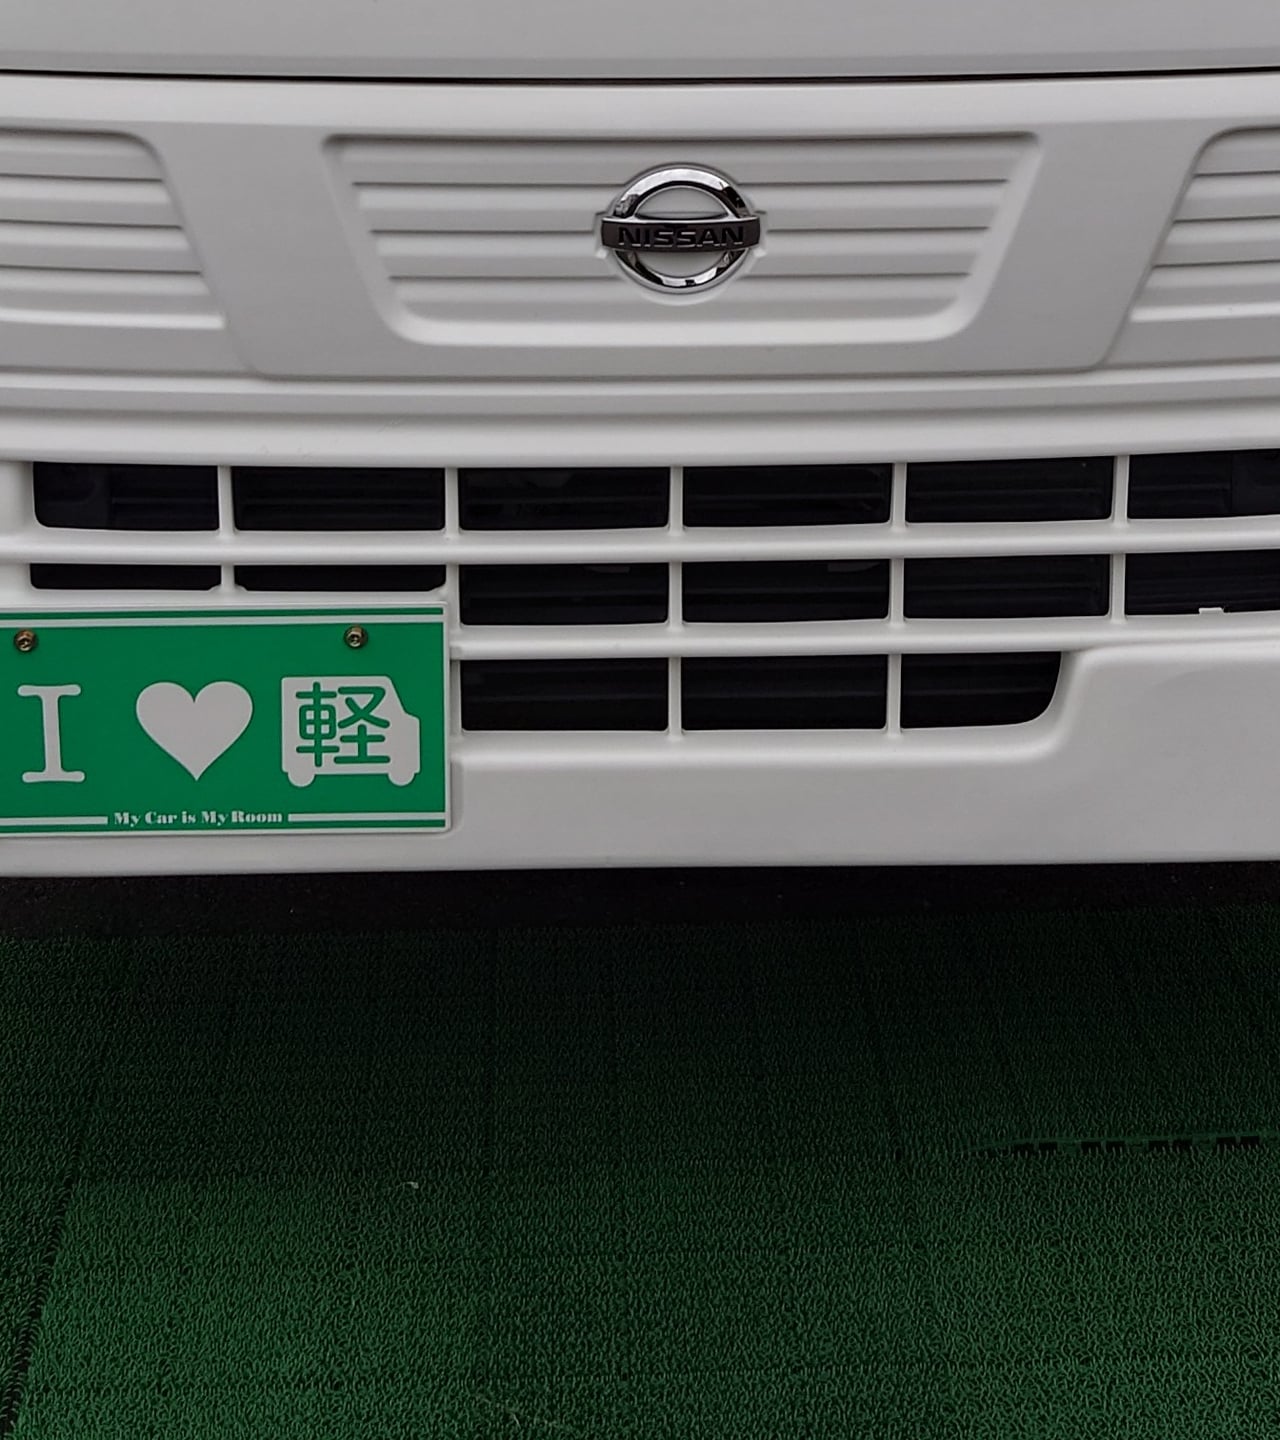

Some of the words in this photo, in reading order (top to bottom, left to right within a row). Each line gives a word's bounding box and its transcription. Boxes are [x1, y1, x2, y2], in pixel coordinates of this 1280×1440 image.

[618, 225, 745, 248] NISSAN
[17, 683, 86, 783] I
[295, 681, 391, 768] 軽
[114, 811, 141, 828] My
[144, 810, 177, 825] Car
[181, 810, 197, 824] is
[200, 810, 228, 827] My
[231, 809, 283, 823] Room
